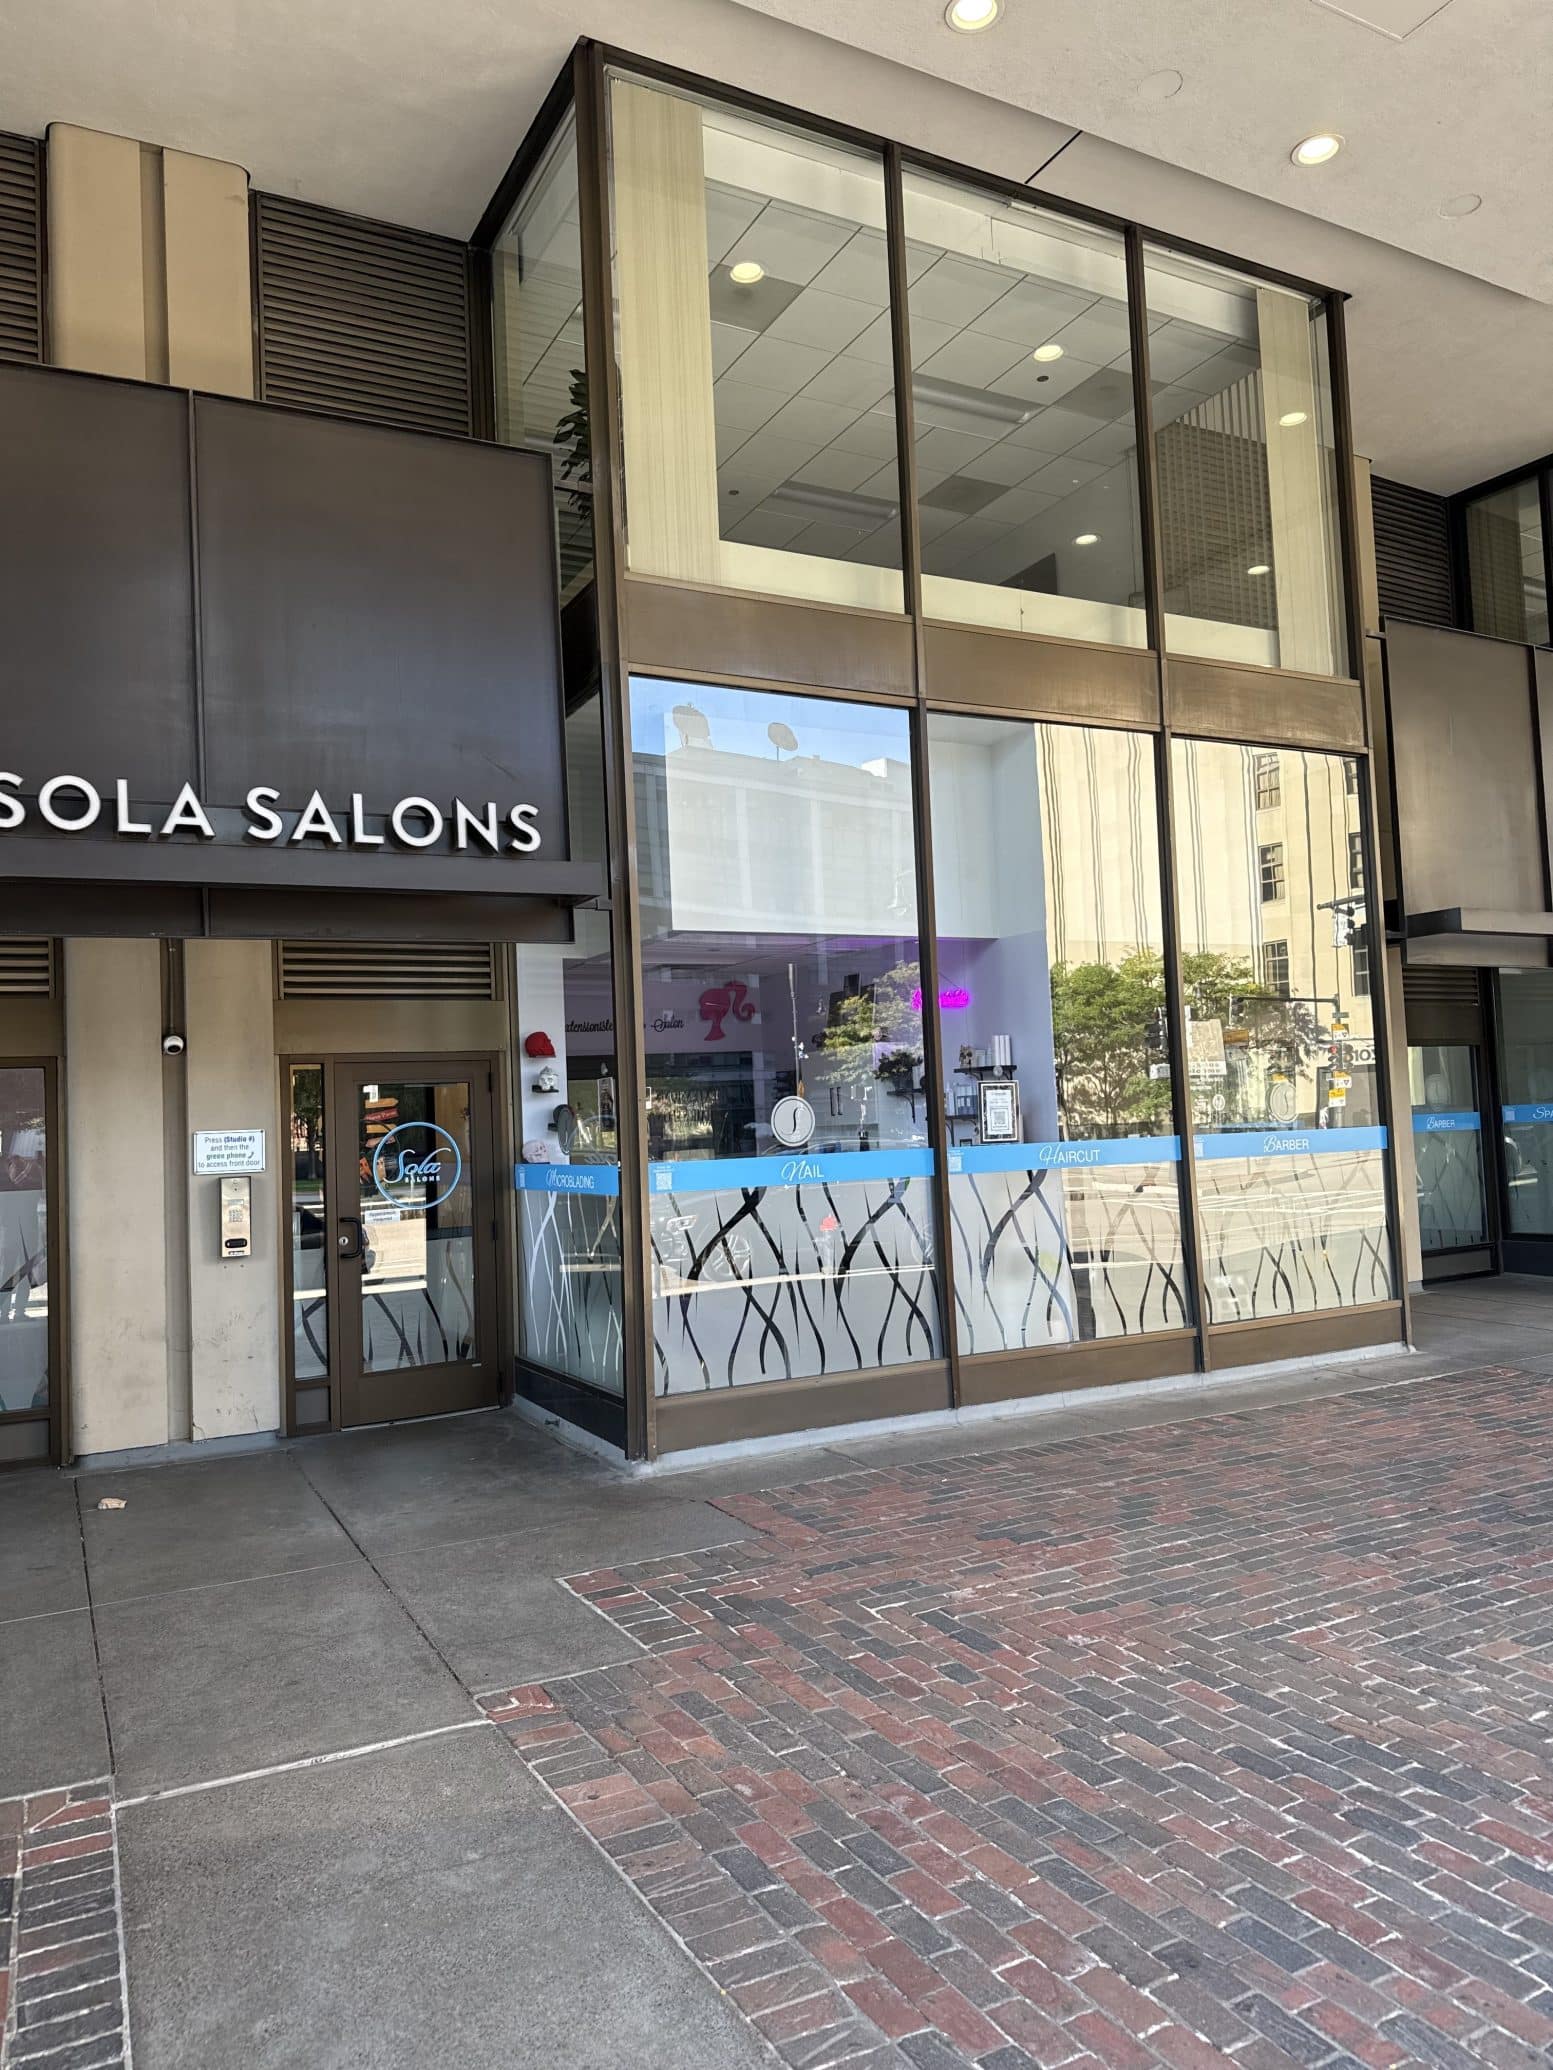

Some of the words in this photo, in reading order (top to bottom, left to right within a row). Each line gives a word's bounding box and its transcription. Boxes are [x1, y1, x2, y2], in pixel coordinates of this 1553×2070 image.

[0, 772, 215, 839] SOLA
[245, 786, 541, 853] SALONS
[1426, 1116, 1456, 1129] BARBER
[224, 1135, 247, 1144] (Studio
[1263, 1135, 1310, 1152] BARBER
[226, 1152, 246, 1160] phone
[1039, 1142, 1100, 1165] HAIRCUT
[383, 1147, 452, 1184] Sola
[780, 1160, 824, 1182] NAIL
[546, 1168, 595, 1188] MICROBLADING
